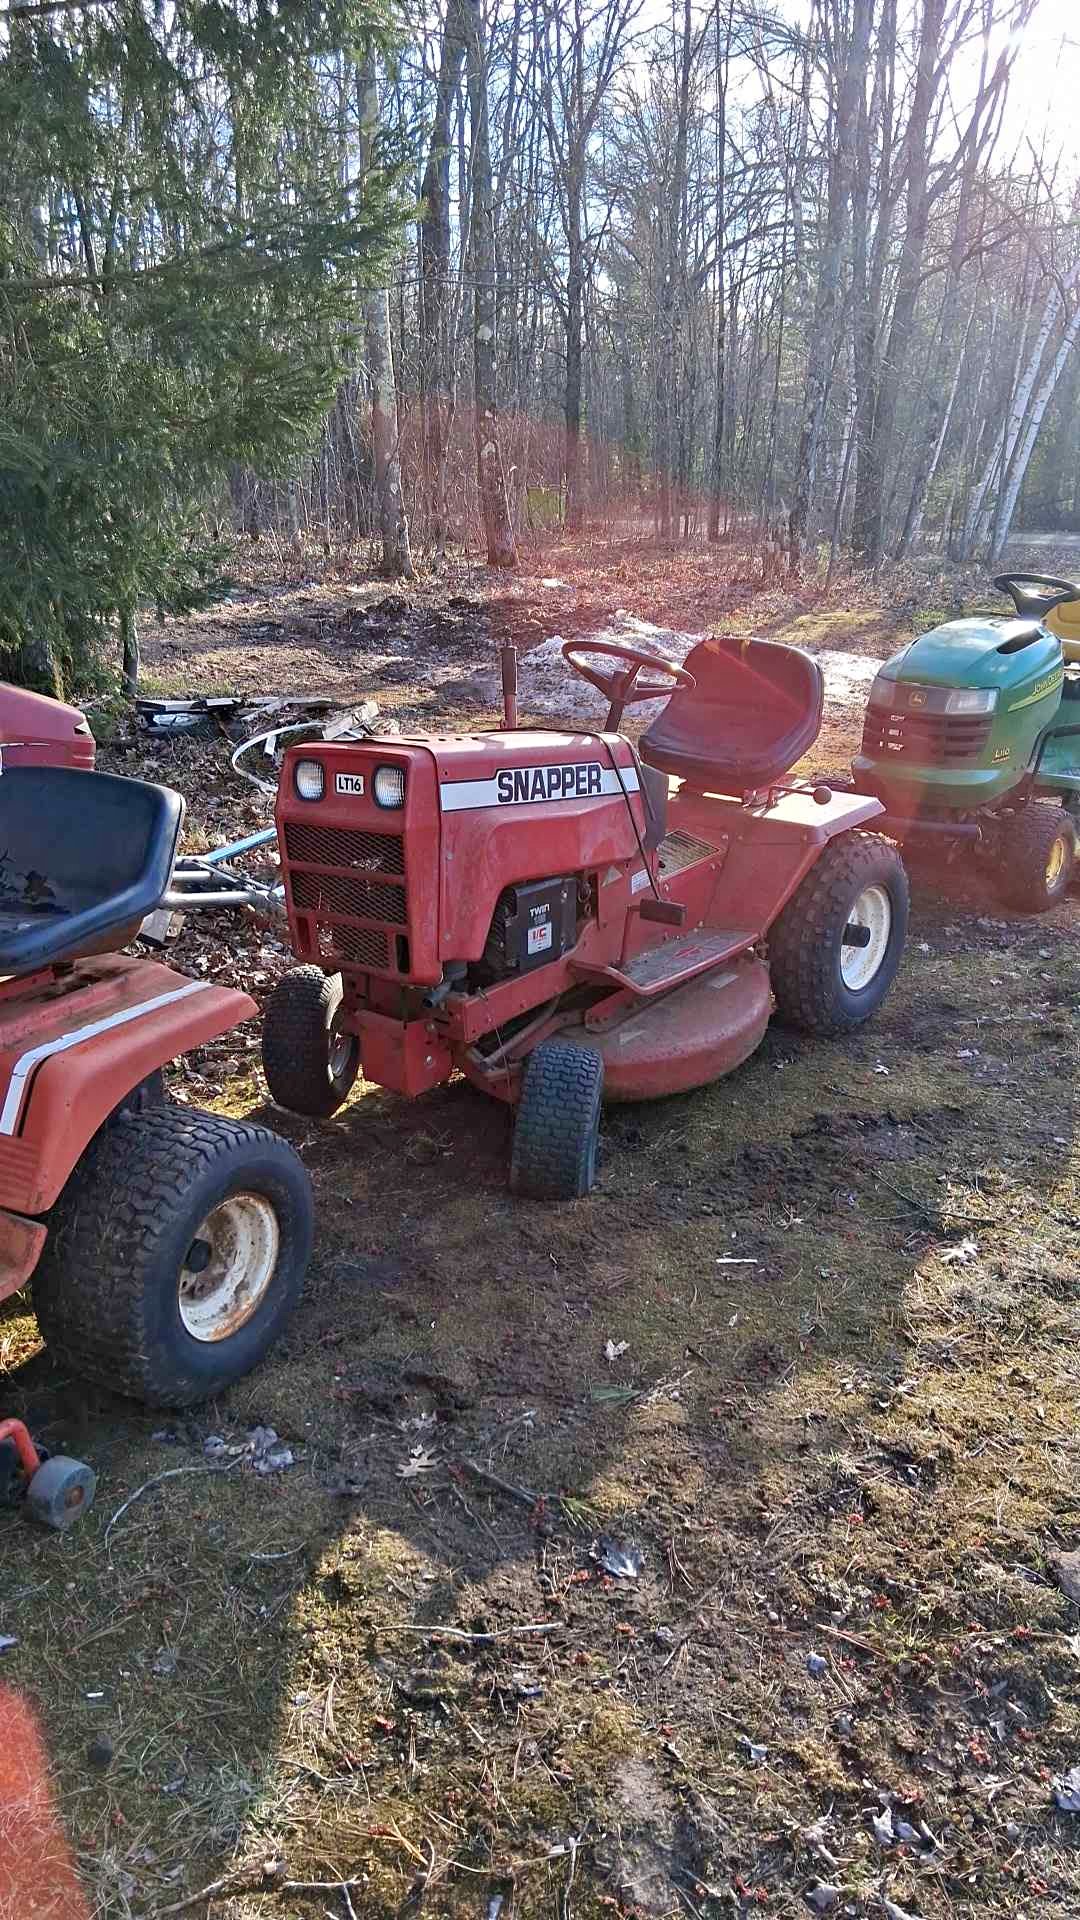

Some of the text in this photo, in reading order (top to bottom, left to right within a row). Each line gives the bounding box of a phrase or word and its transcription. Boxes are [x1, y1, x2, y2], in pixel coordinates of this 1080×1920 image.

[338, 776, 361, 792] LT16
[498, 764, 601, 802] SNAPPER
[530, 903, 550, 917] TWIN
